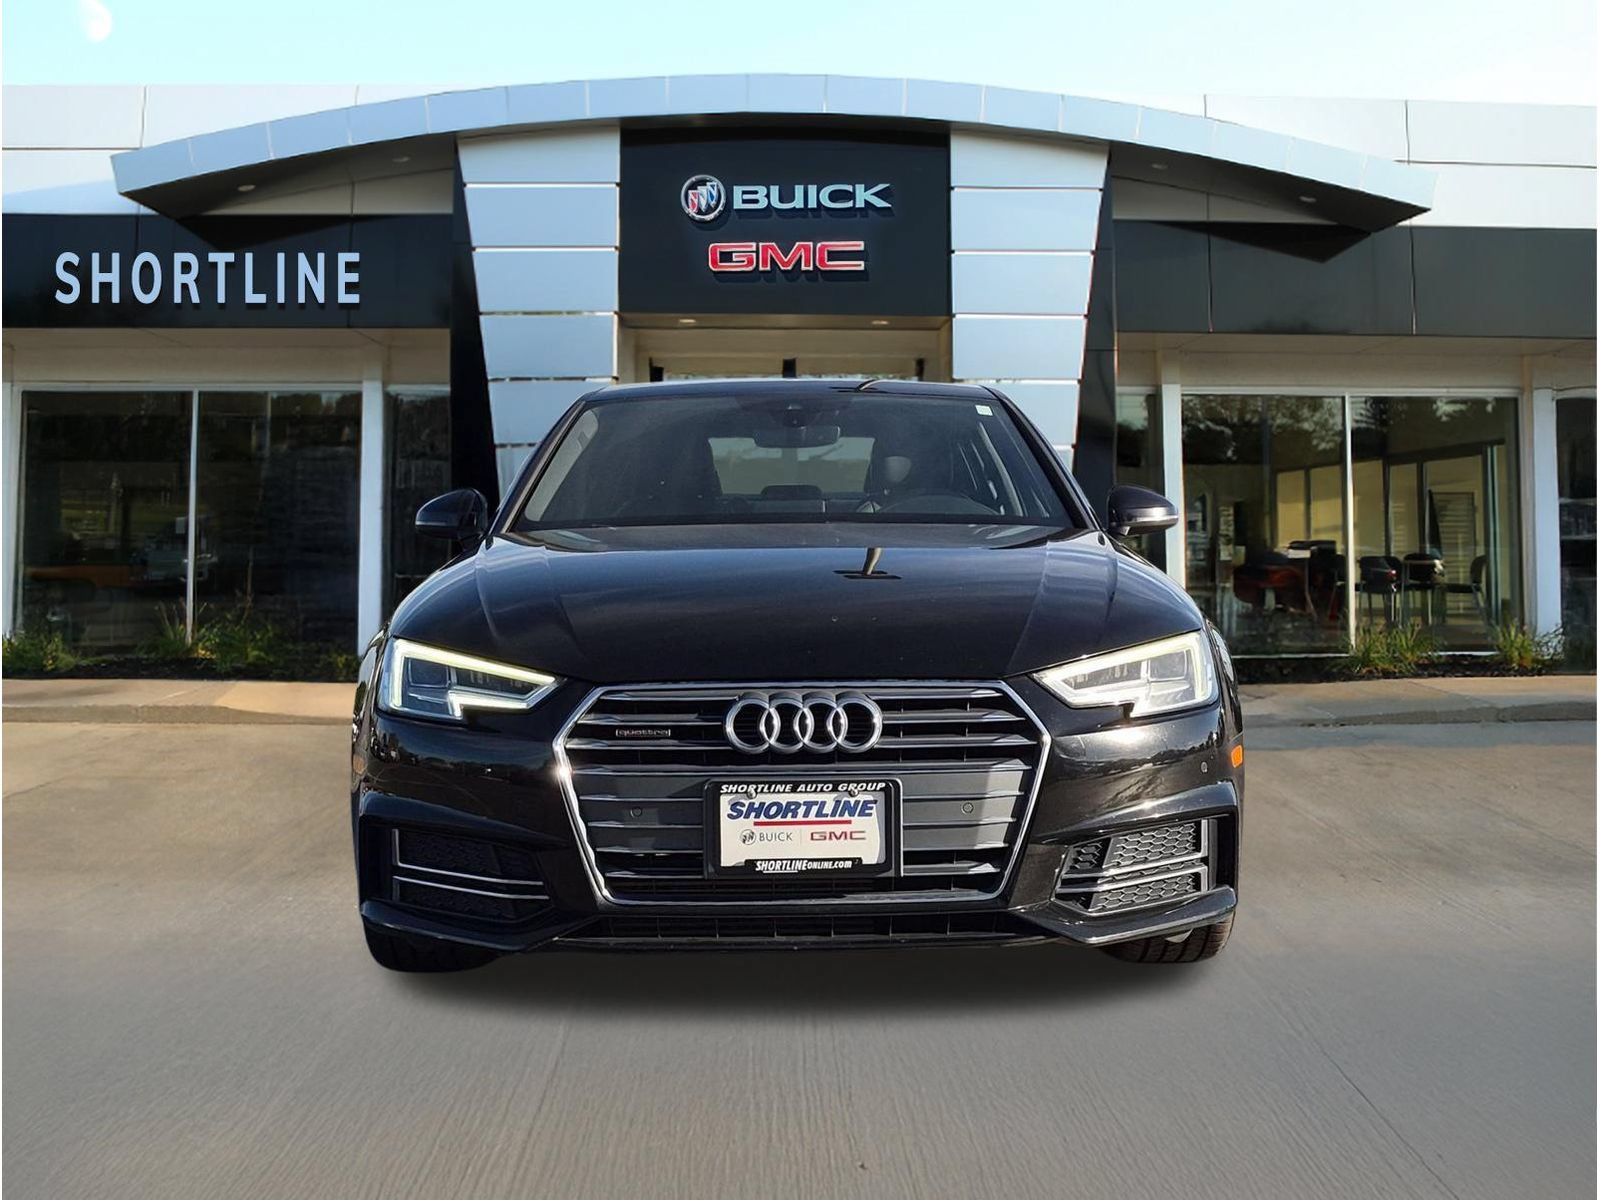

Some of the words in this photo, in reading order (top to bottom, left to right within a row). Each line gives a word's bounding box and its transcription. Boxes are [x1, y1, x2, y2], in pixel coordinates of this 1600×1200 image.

[733, 183, 892, 210] BUICK
[708, 240, 865, 271] GMC
[54, 251, 361, 304] SHORTLINE
[720, 783, 793, 794] SHORTLINE
[796, 783, 833, 793] AUTO
[837, 782, 886, 793] GROUP
[727, 799, 878, 820] SHORTLINE
[758, 831, 793, 842] BUICK
[810, 830, 867, 841] GMC
